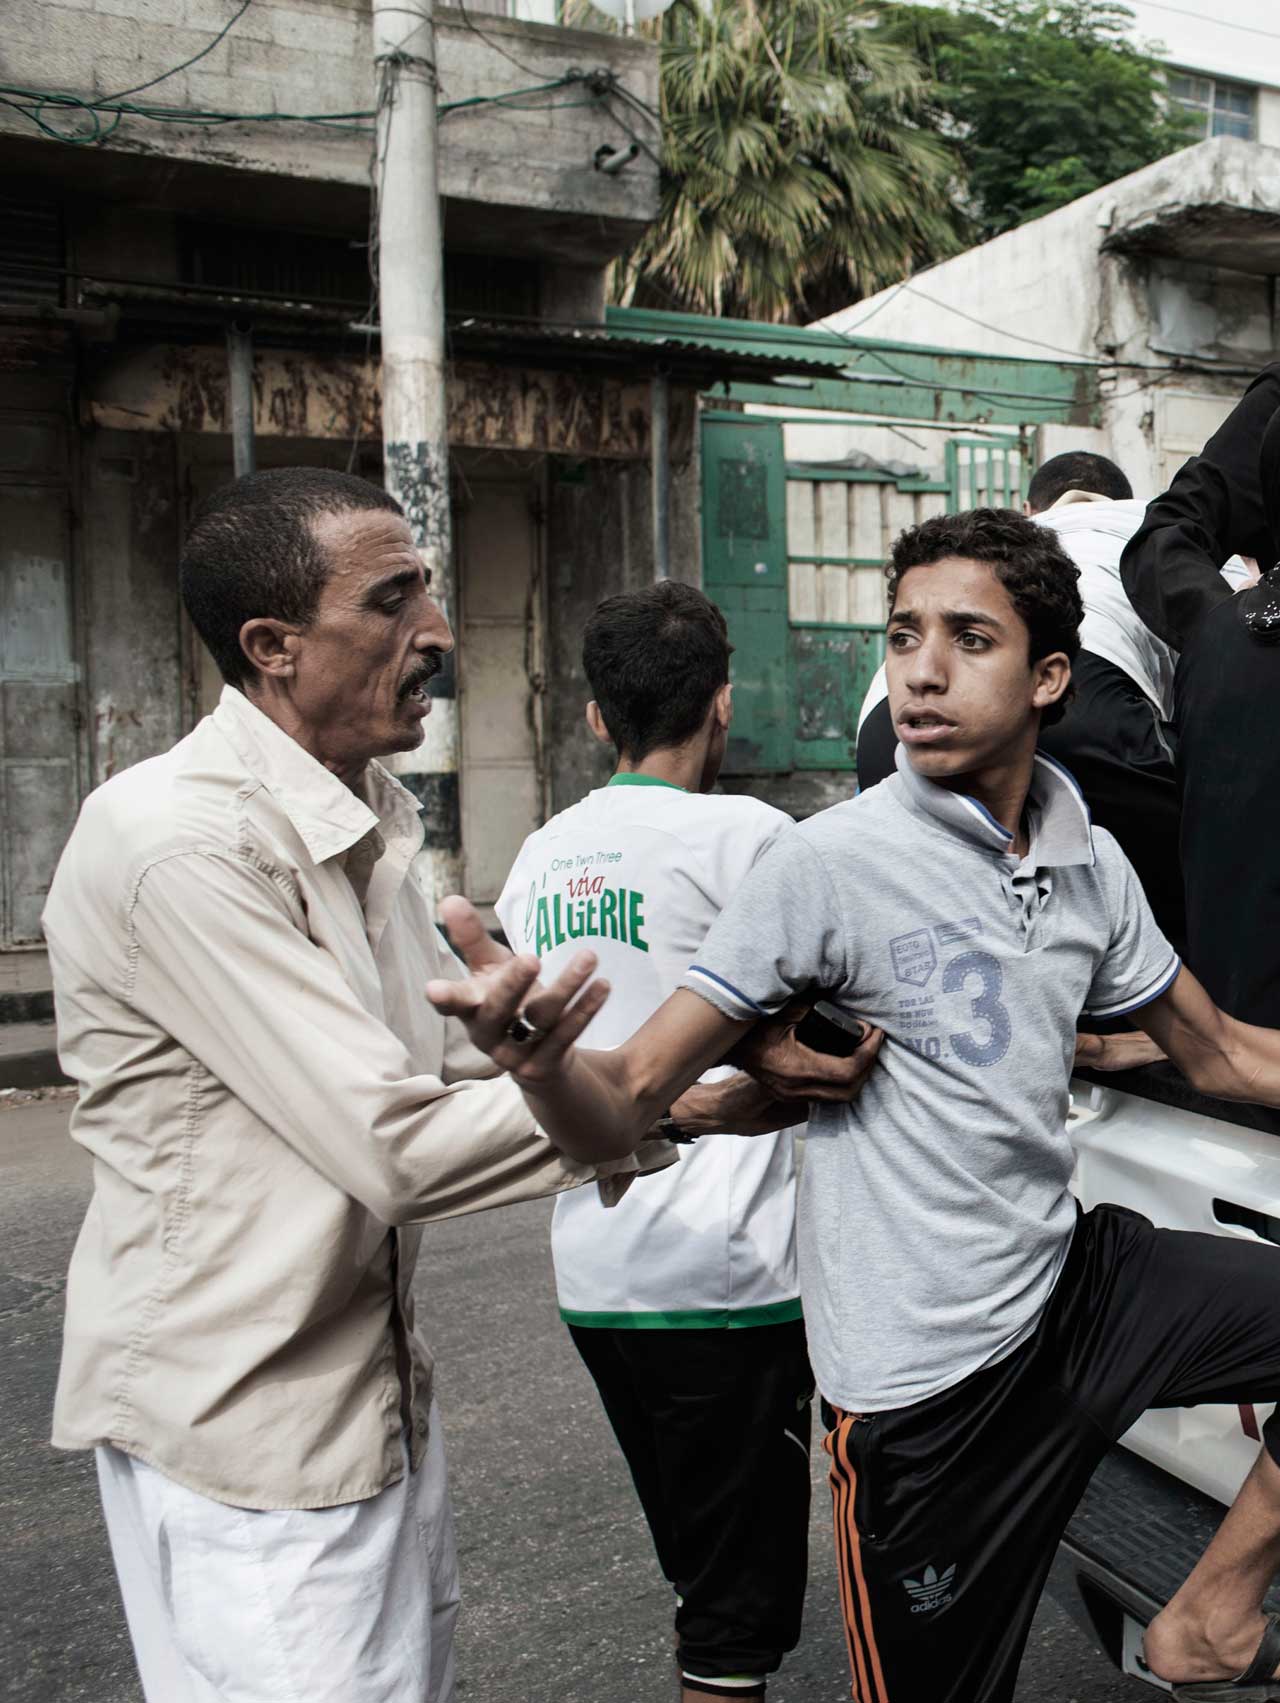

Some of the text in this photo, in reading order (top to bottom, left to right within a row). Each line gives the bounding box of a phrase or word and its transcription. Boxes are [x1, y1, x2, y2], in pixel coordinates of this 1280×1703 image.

[551, 858, 574, 872] One
[596, 851, 623, 865] Three
[566, 867, 605, 898] viva
[942, 950, 1012, 1067] 3
[909, 1592, 953, 1613] adidas
